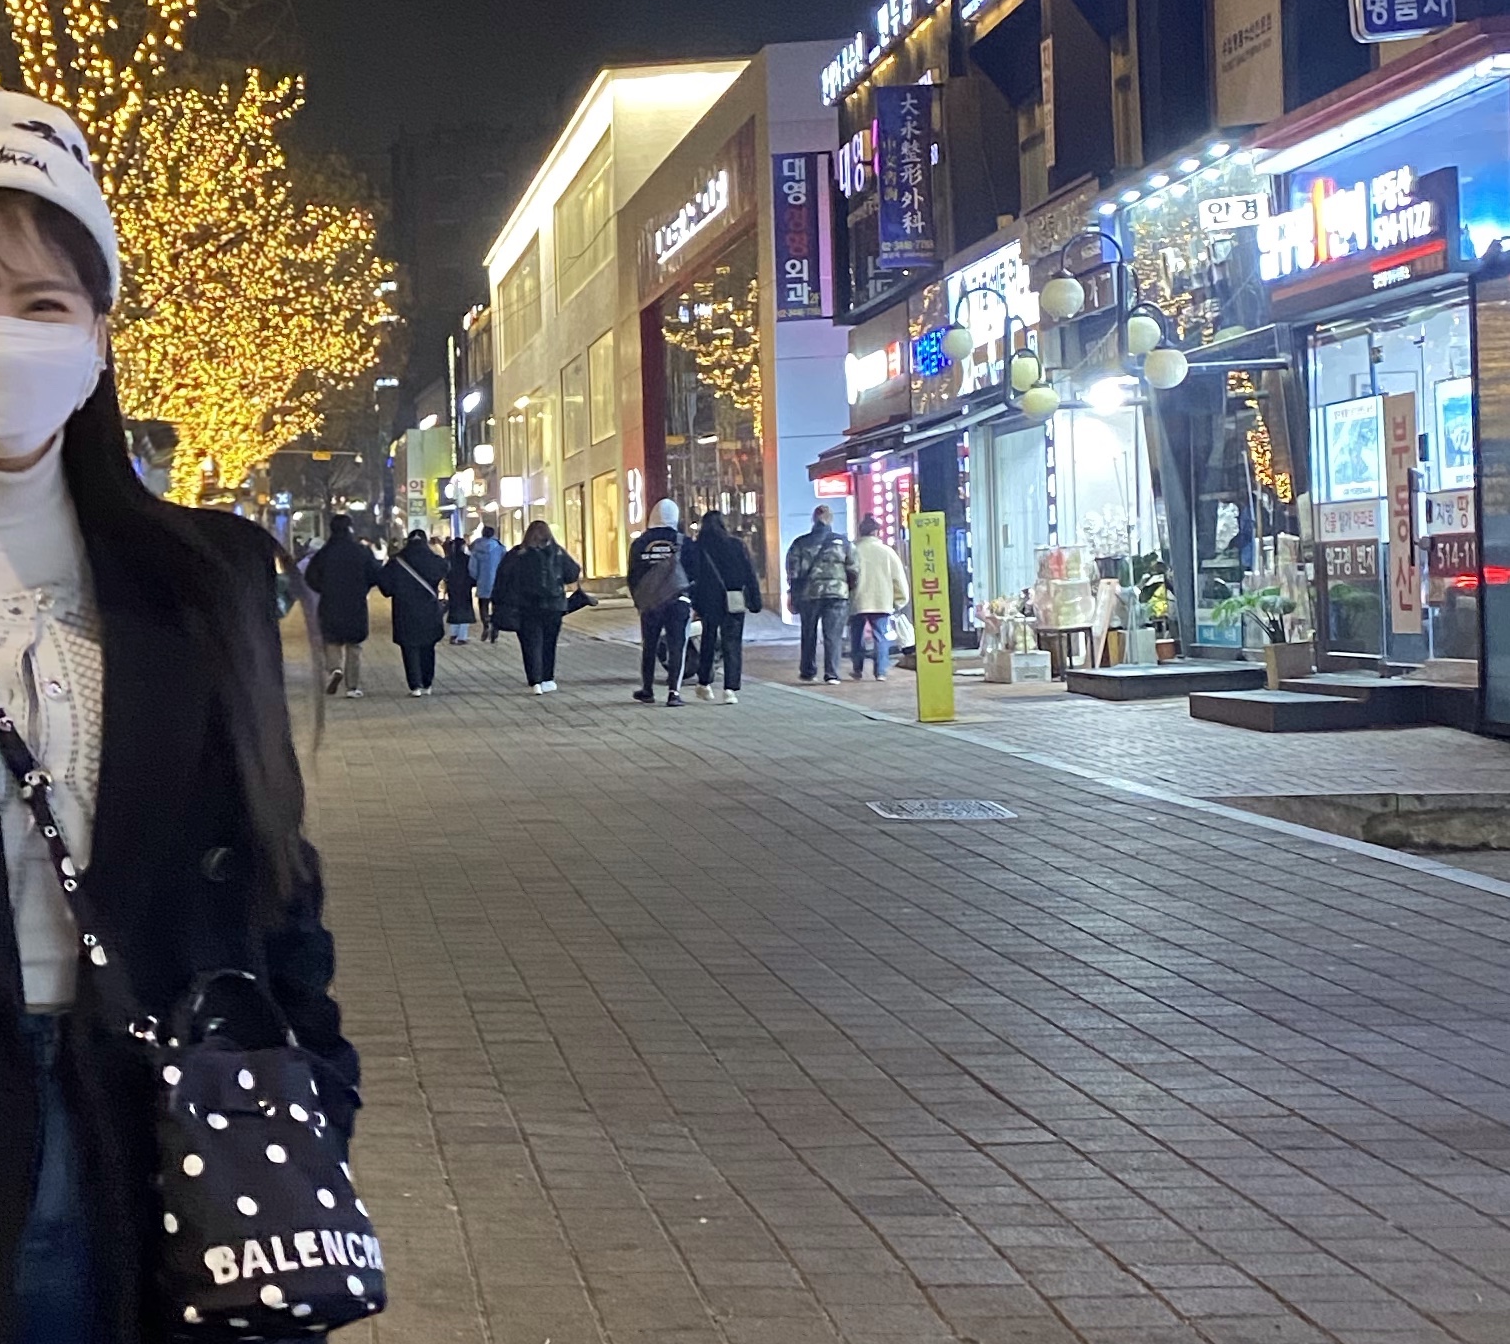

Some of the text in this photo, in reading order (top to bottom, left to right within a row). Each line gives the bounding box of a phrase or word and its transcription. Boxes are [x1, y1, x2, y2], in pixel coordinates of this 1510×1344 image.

[1207, 197, 1259, 223] 안경
[1391, 415, 1414, 611] 부동산
[919, 577, 945, 664] 부동산
